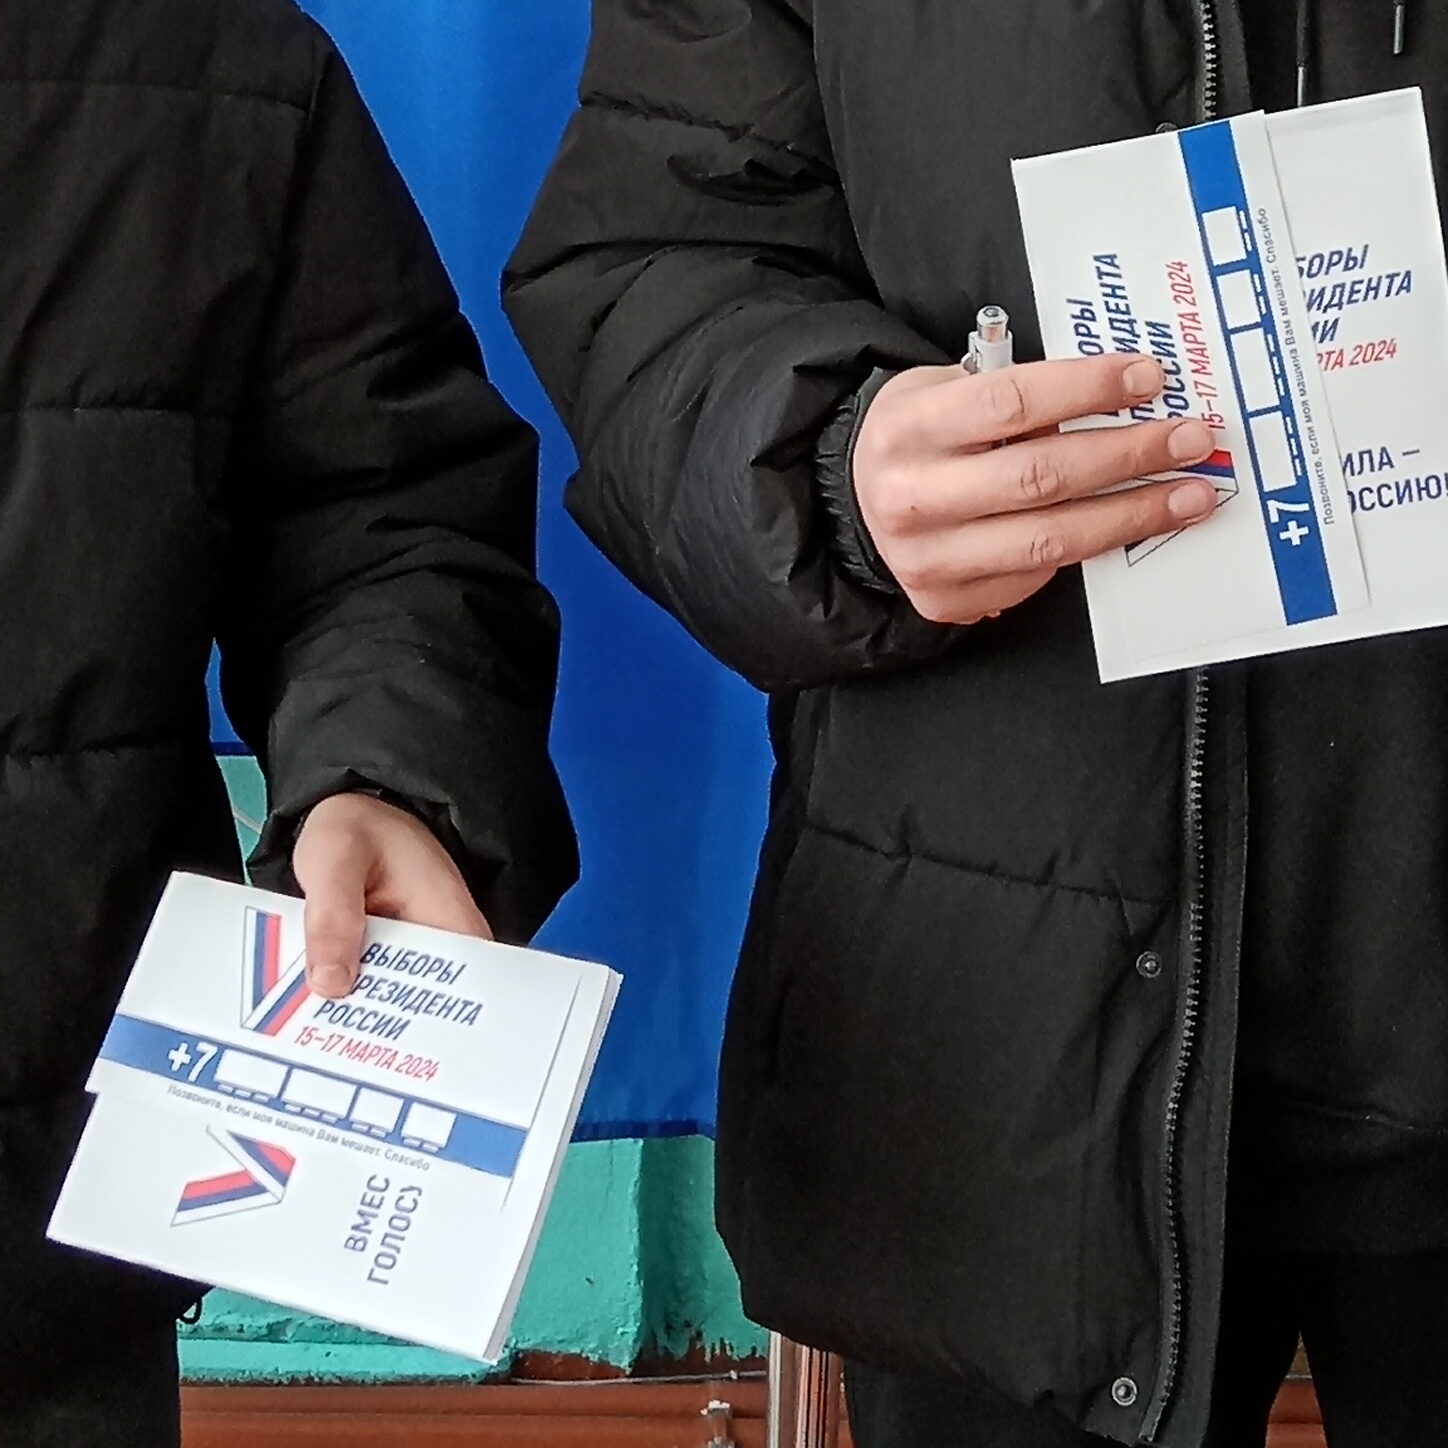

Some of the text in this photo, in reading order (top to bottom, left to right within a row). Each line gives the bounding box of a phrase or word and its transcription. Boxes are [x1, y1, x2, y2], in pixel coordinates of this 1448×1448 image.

[1257, 208, 1277, 264] Спасибо
[1165, 260, 1198, 307] 2024
[1304, 270, 1412, 314] ИДЕНТА
[1066, 298, 1106, 356] ОРЫ
[1177, 312, 1213, 377] МАРТА
[1283, 319, 1296, 346] Вам
[1290, 348, 1307, 397] машина
[1349, 338, 1398, 367] 2024
[1302, 400, 1315, 425] моя
[1307, 426, 1320, 455] если
[1342, 445, 1395, 477] ИЛА
[1266, 499, 1310, 546] +7
[360, 942, 467, 985] ВЫБОРЫ
[313, 999, 412, 1041] РОССИИ
[168, 1042, 219, 1083] +7
[338, 1037, 399, 1071] МАРТА
[395, 1054, 440, 1082] 2024
[226, 1103, 252, 1118] если
[253, 1111, 273, 1124] моя
[275, 1118, 315, 1137] машина
[316, 1129, 339, 1144] Вам
[384, 1148, 431, 1172] Спасибо
[344, 1174, 390, 1253] ВМЕС
[367, 1185, 423, 1285] ГОЛОСУ
